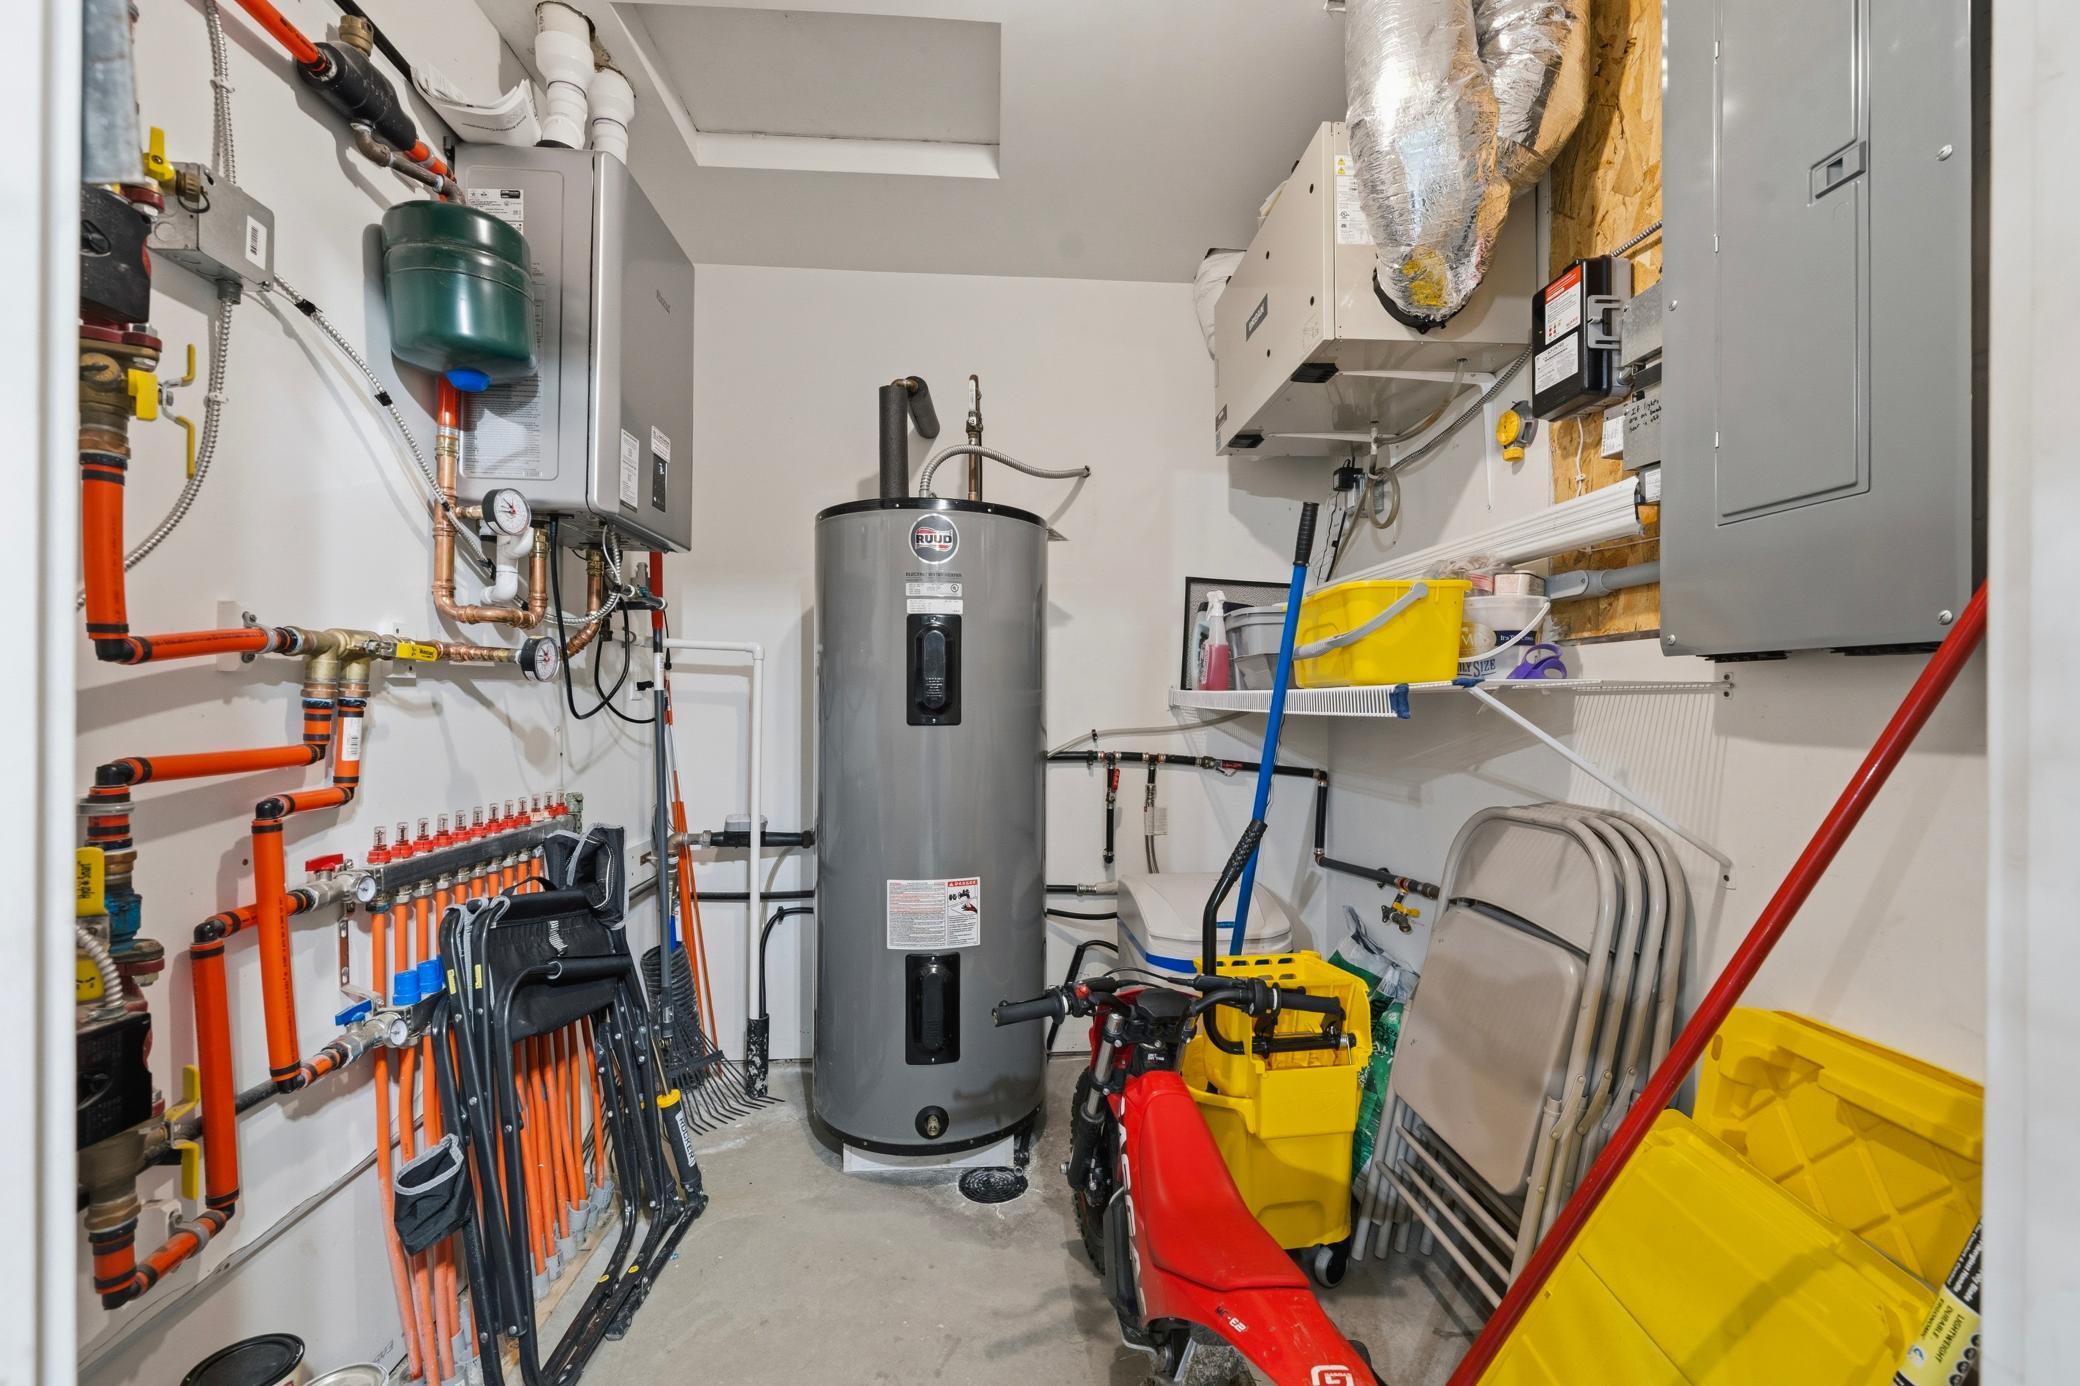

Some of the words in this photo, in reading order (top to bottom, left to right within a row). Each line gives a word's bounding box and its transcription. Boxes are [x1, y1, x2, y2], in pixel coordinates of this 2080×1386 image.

[916, 534, 953, 544] RUUD
[679, 1118, 695, 1160] ROCKER
[1933, 1305, 1954, 1339] DURABLE
[1934, 1313, 1965, 1364] LIGHTWEIGHT
